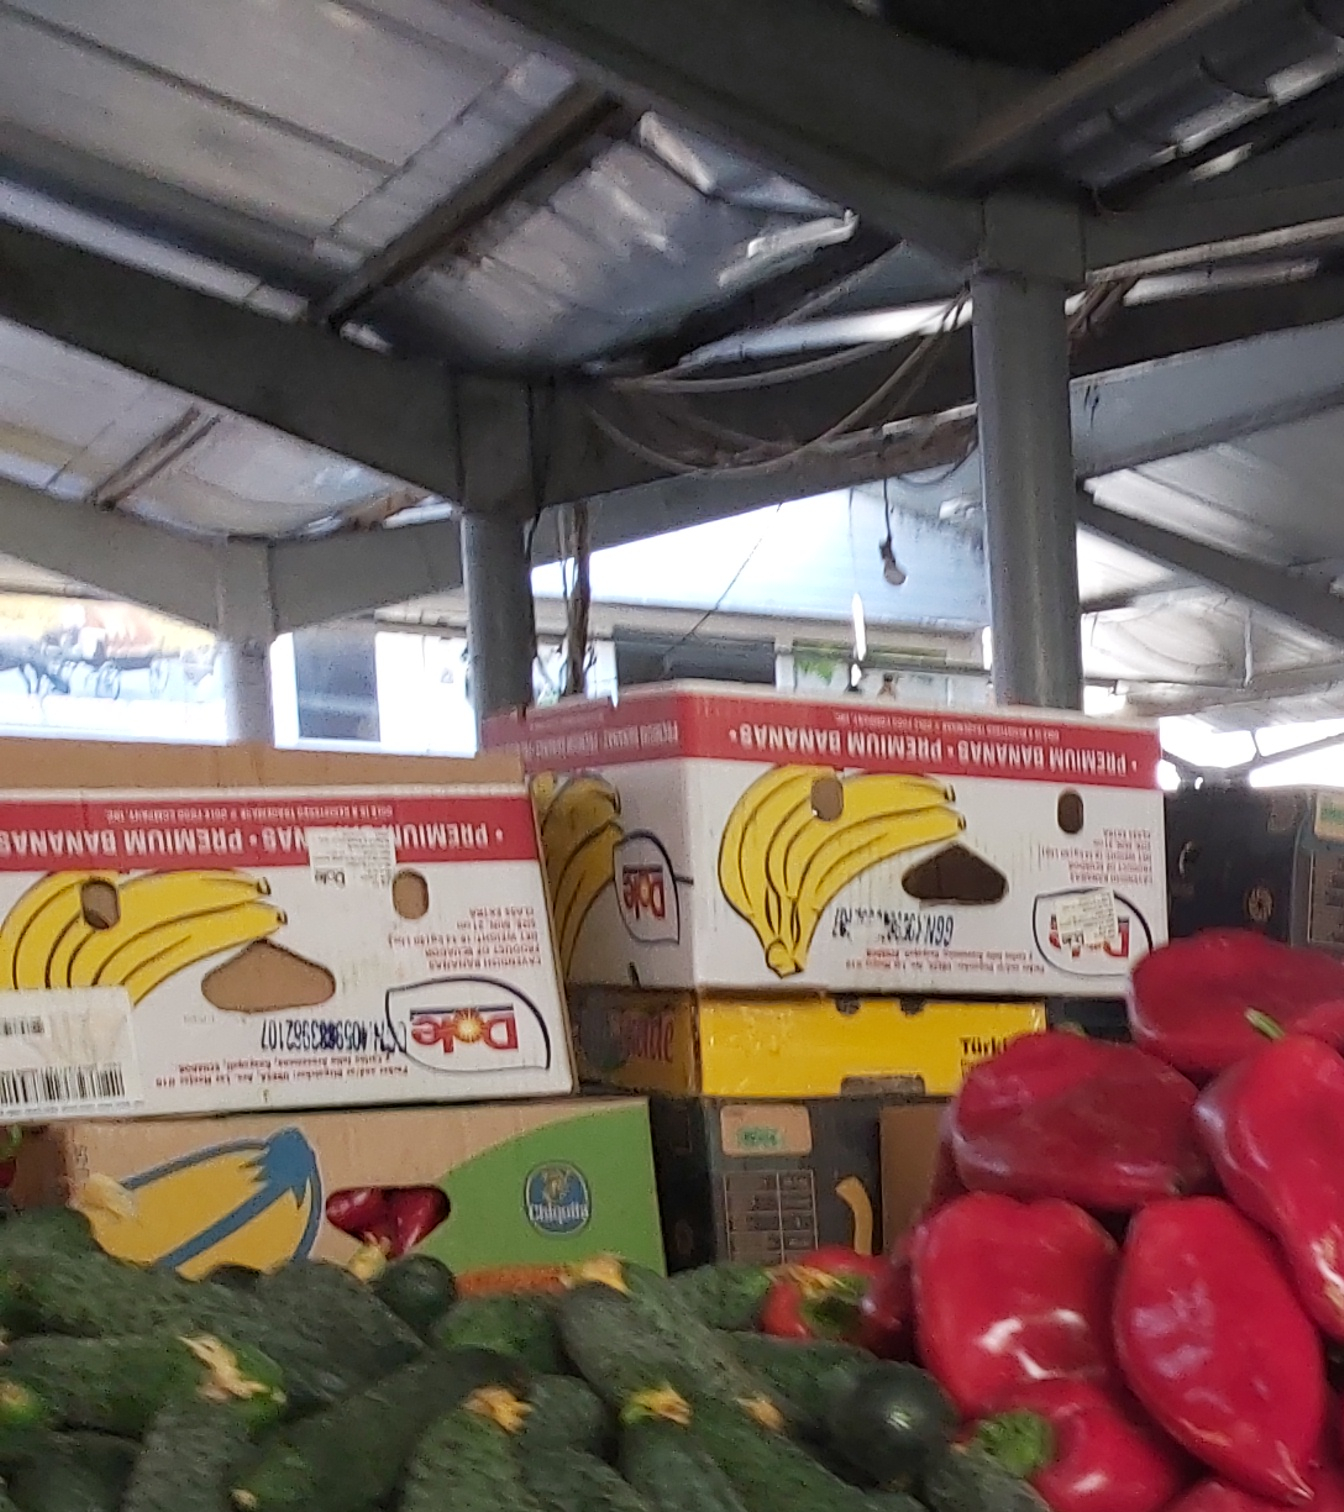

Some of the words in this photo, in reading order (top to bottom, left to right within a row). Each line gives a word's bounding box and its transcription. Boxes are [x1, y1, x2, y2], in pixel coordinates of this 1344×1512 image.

[740, 723, 840, 756] BANANAS
[847, 730, 941, 763] PREMIUM
[958, 740, 1043, 770] BANANAS
[1049, 747, 1126, 776] PREMIUM
[123, 827, 243, 856] PREMIUM
[623, 870, 665, 921] Dole
[410, 1009, 518, 1055] Dole
[529, 1202, 588, 1224] Chiquita
